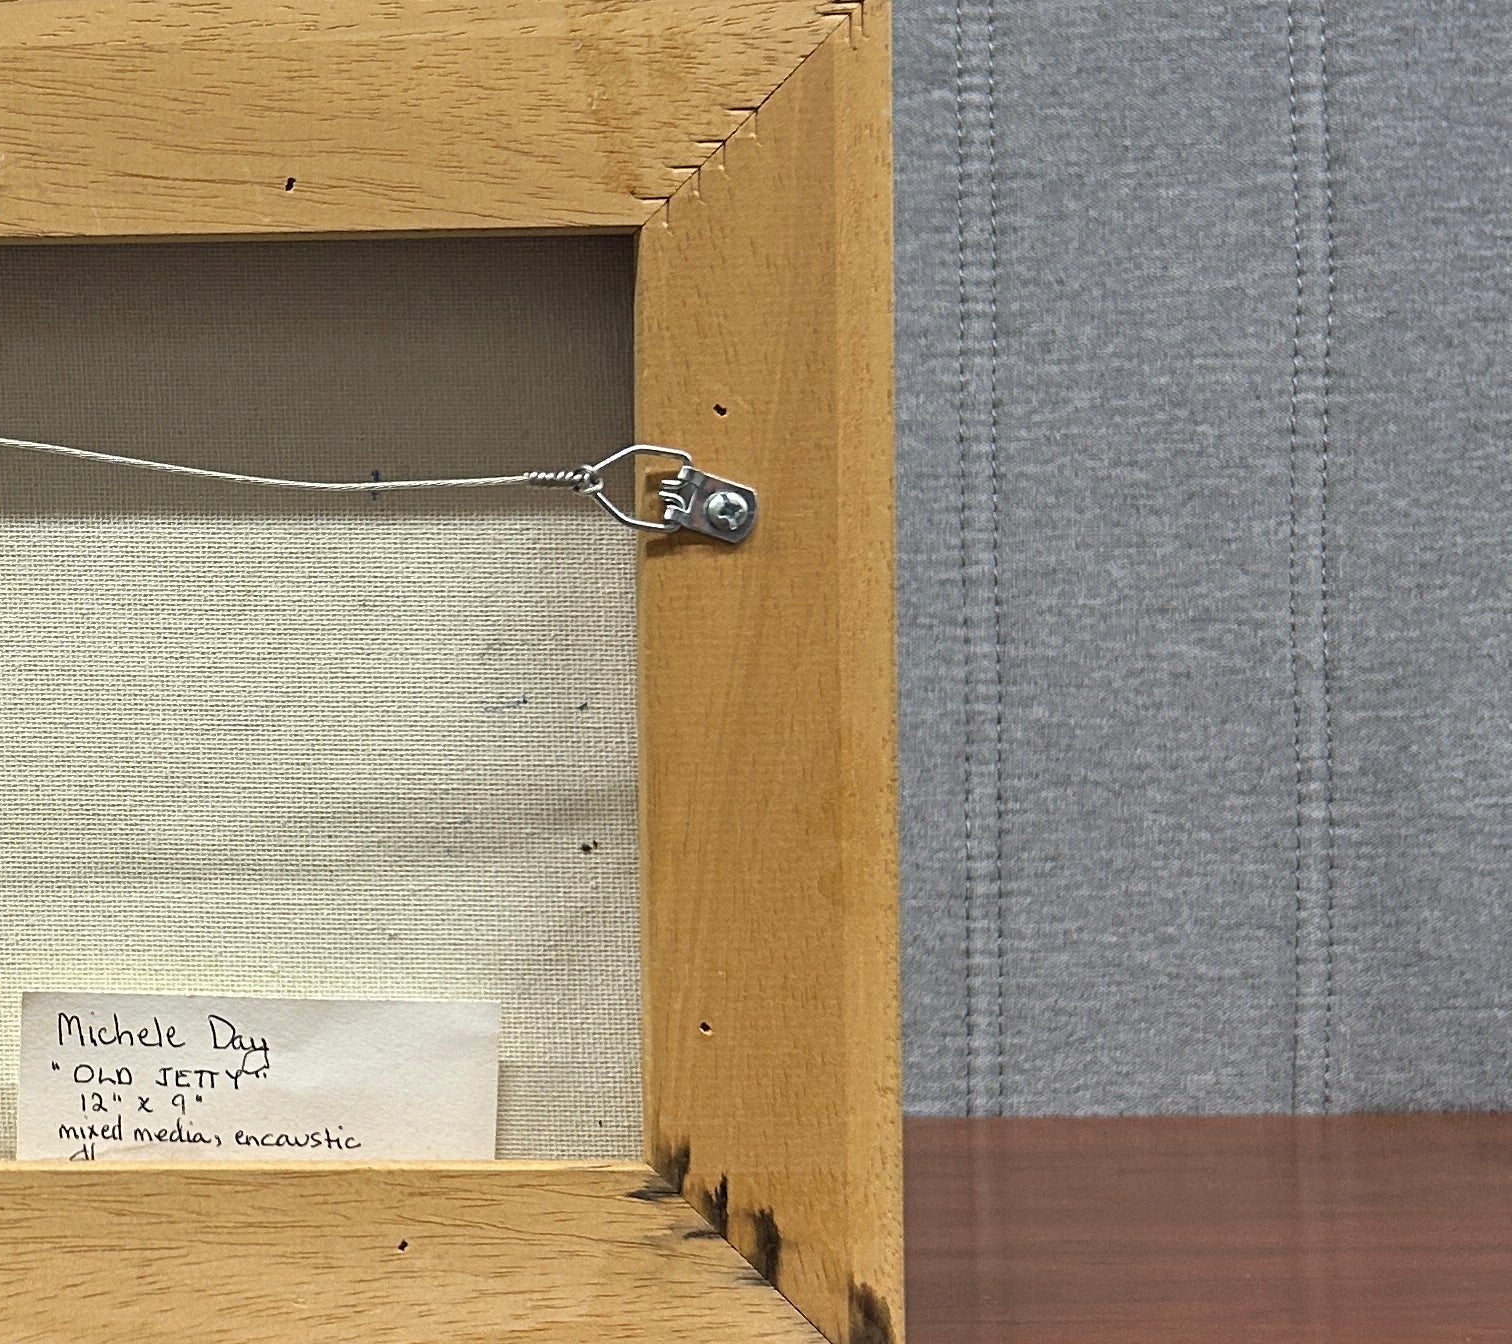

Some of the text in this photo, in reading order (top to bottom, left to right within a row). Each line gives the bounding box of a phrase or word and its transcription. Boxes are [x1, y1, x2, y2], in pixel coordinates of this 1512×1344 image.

[57, 1011, 270, 1074] Michele Day
[80, 1092, 122, 1112] 12"
[137, 1096, 154, 1113] x
[58, 1114, 362, 1150] mixed media, encaustic
